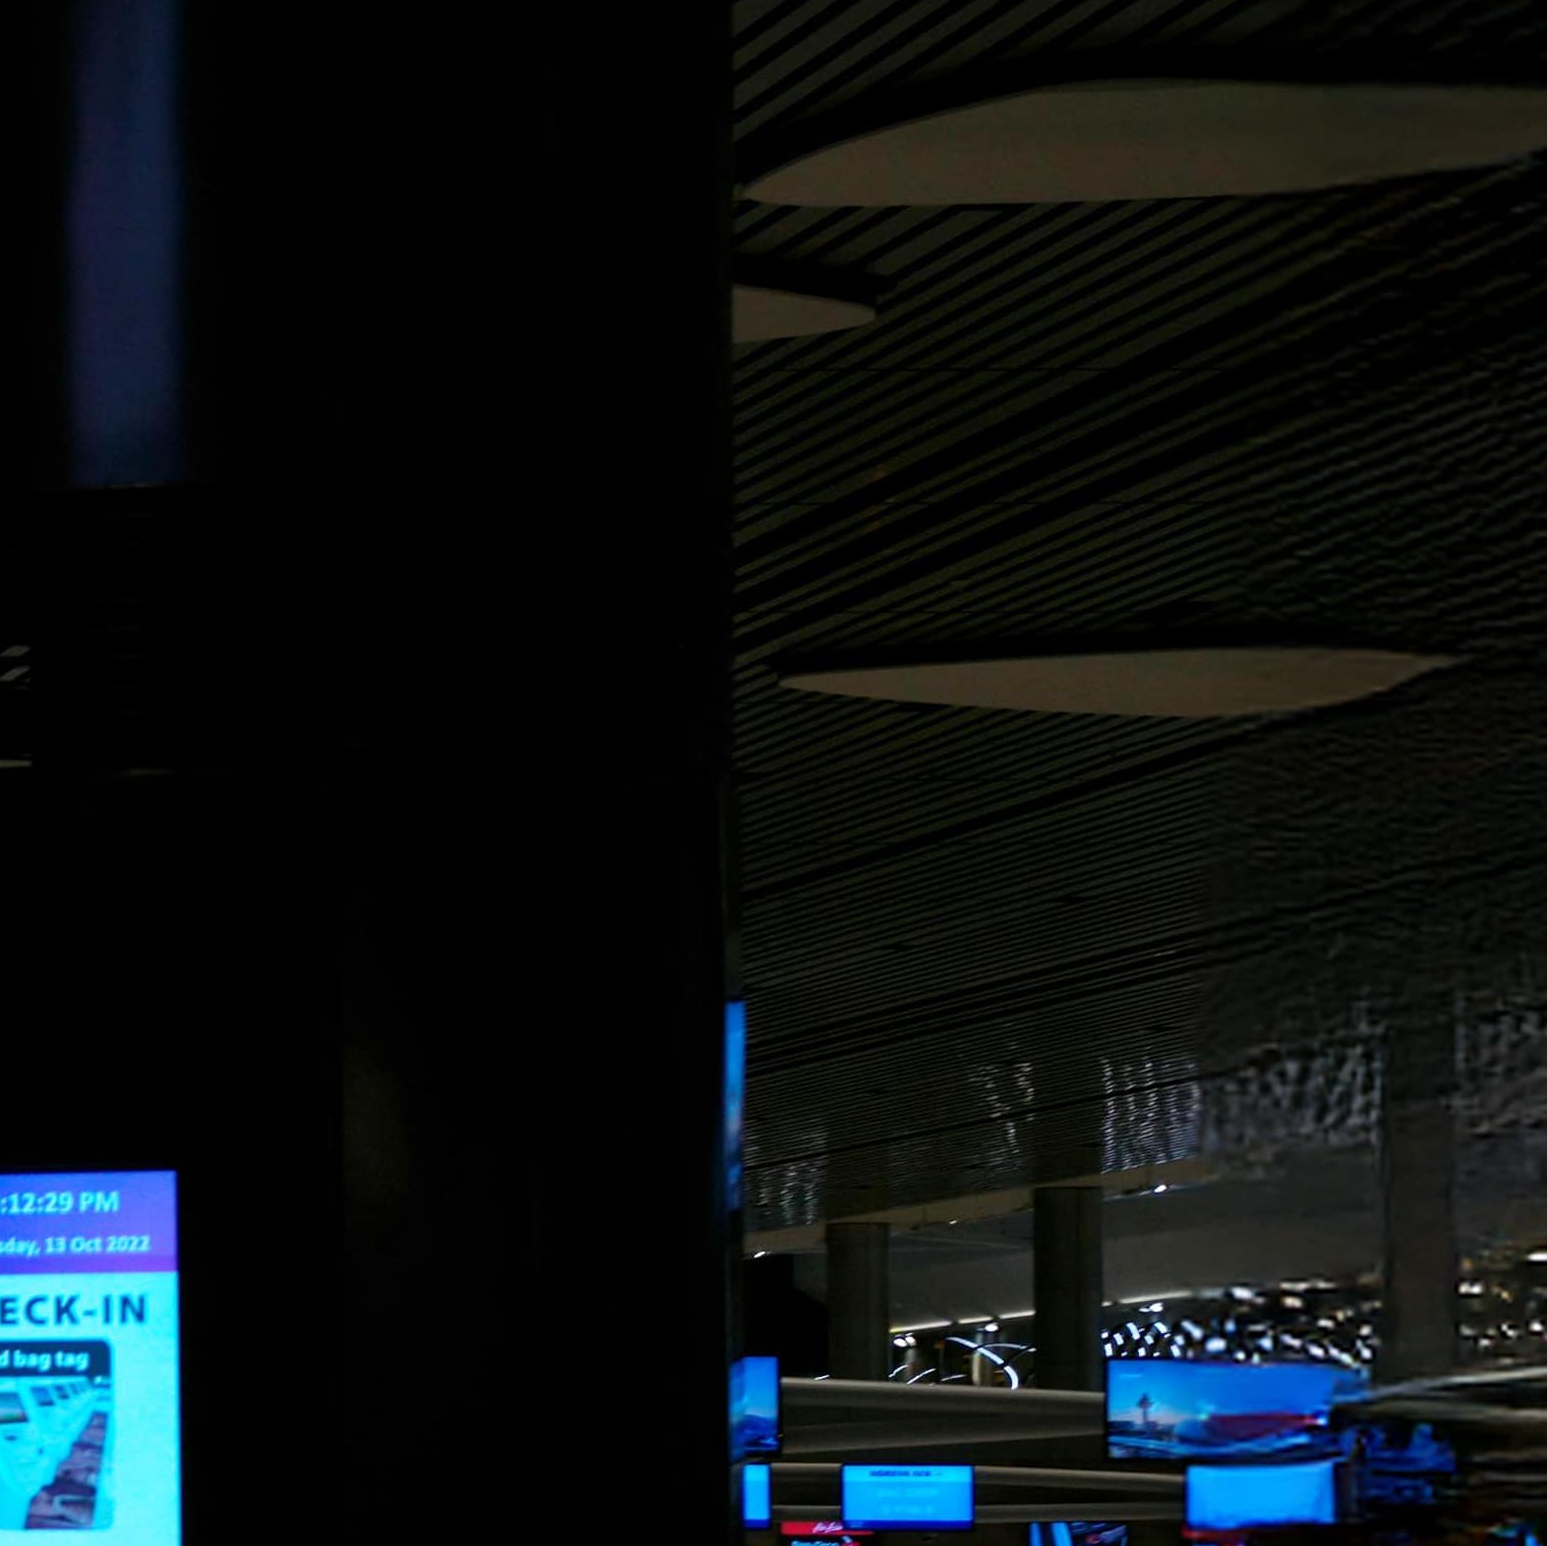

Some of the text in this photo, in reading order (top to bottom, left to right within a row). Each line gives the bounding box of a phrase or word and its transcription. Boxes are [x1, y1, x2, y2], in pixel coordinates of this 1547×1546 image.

[79, 1191, 120, 1213] PM
[45, 1237, 67, 1253] 13
[70, 1236, 102, 1252] Oct
[13, 1350, 50, 1372] bag
[54, 1351, 89, 1371] tag
